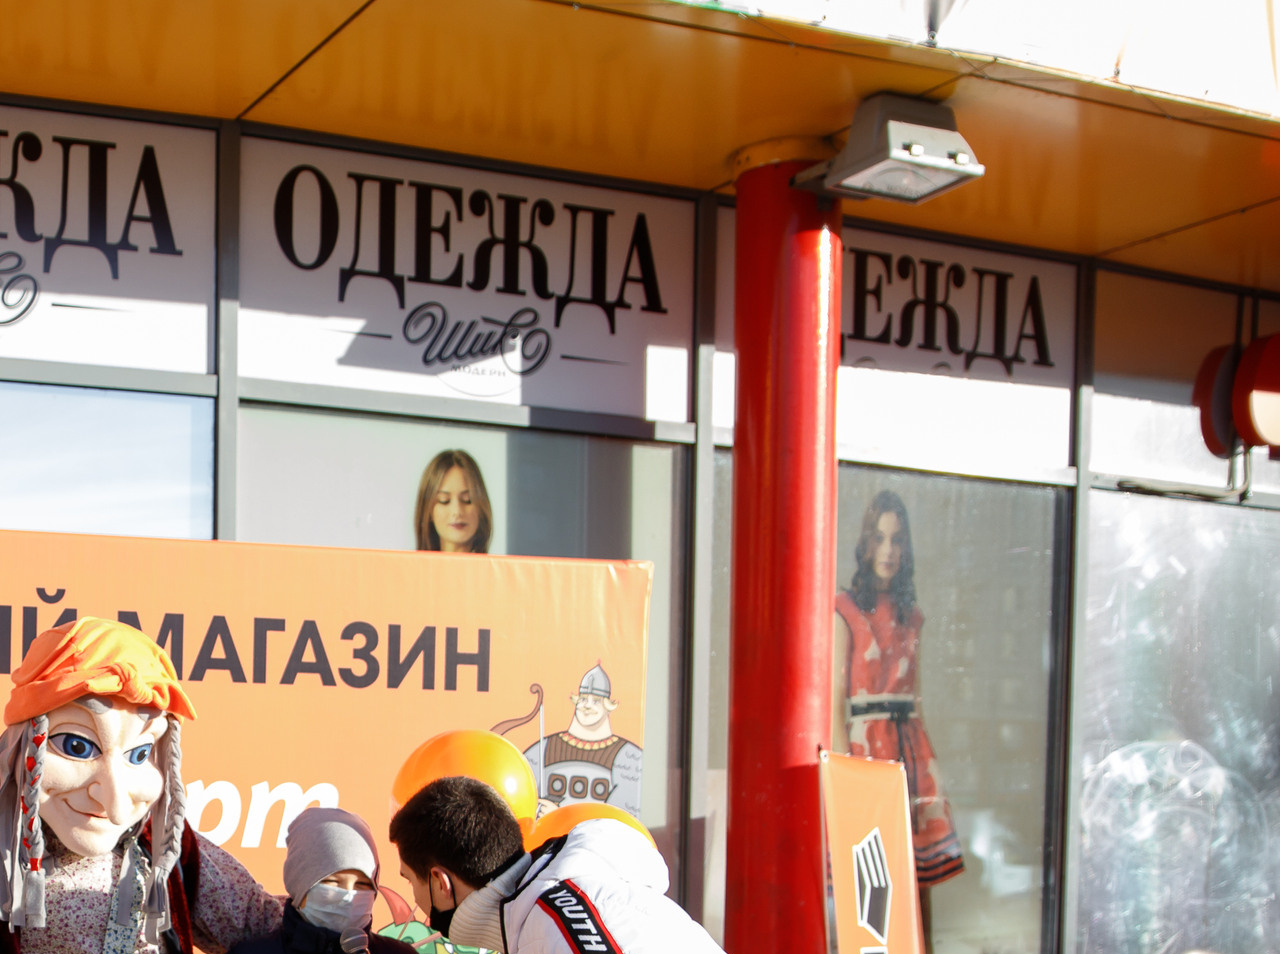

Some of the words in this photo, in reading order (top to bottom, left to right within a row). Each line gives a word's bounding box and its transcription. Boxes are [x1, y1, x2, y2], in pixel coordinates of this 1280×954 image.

[273, 163, 668, 335] ОДЕЖДА
[840, 247, 1055, 377] ЕЖДА
[548, 888, 608, 952] YOUTH
